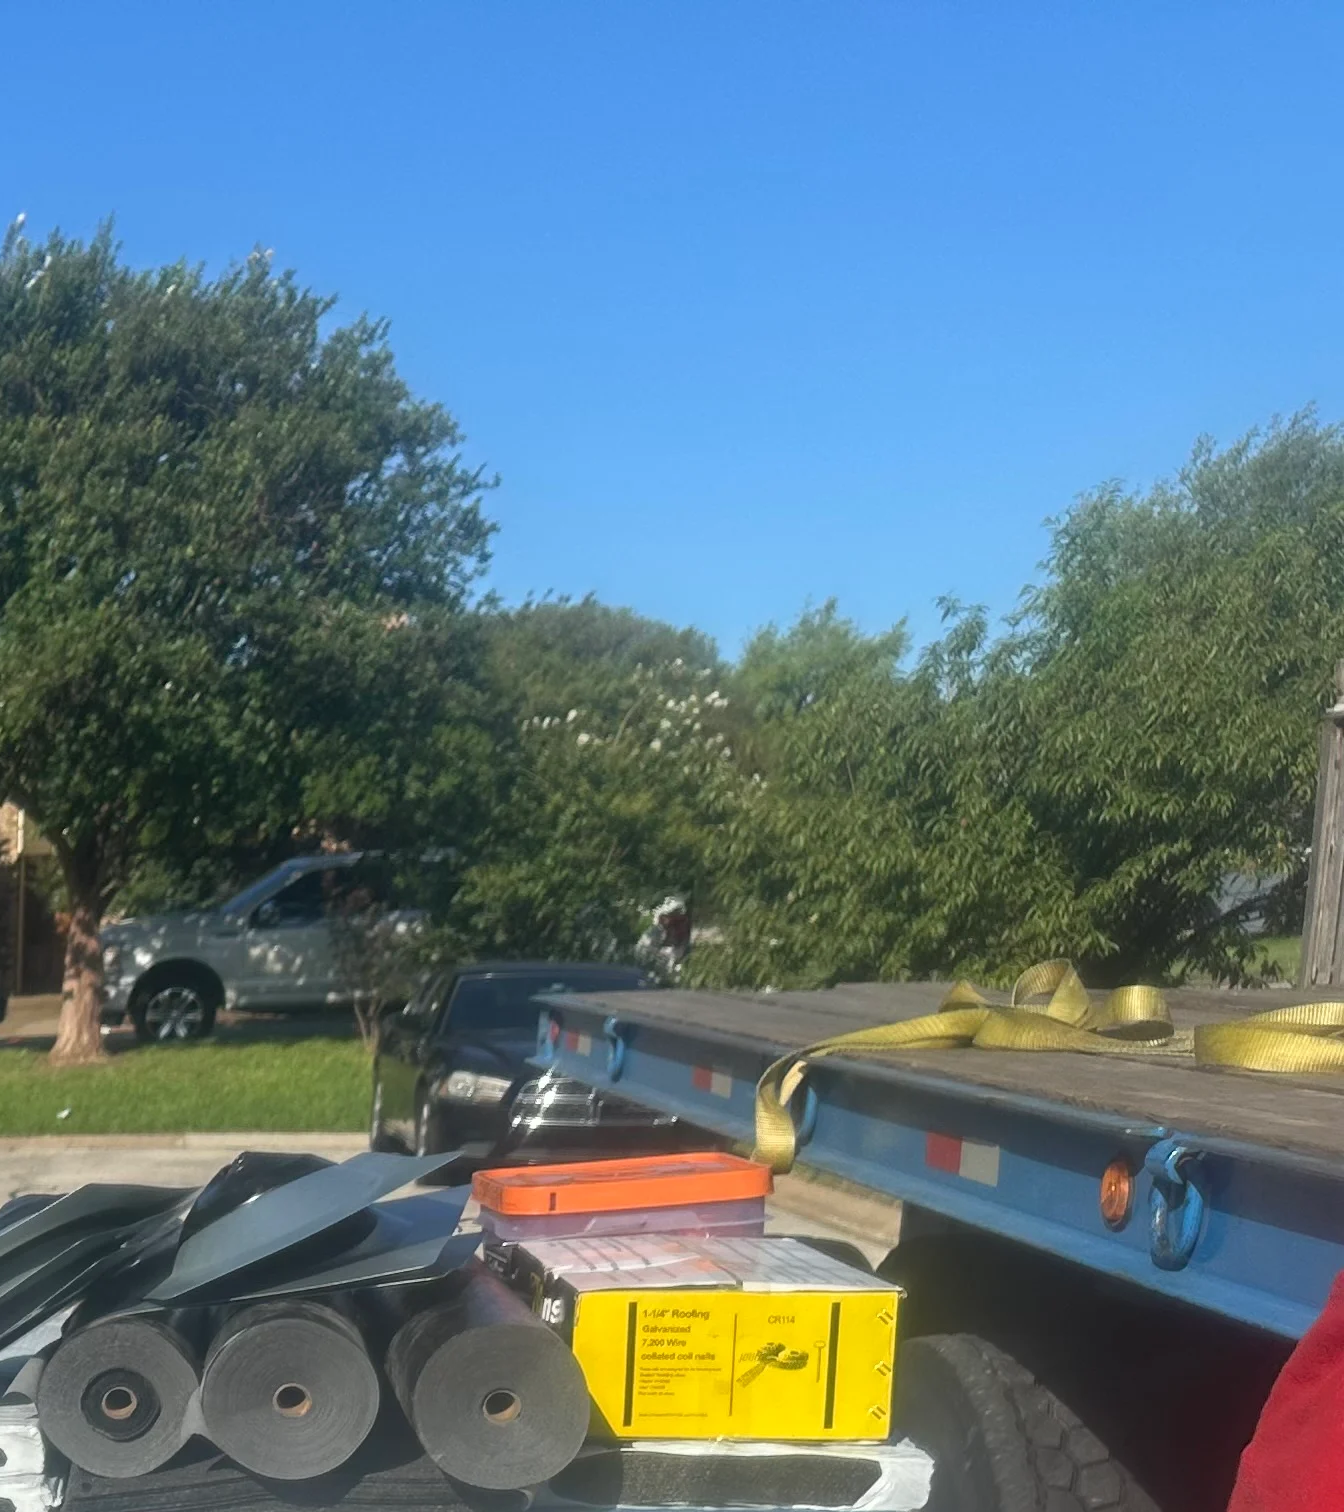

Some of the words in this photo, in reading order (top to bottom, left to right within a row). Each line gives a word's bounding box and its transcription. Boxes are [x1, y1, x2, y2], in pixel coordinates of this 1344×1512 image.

[672, 1309, 710, 1320] Roofing
[768, 1315, 795, 1324] CR114
[642, 1325, 691, 1333] Galvanized
[667, 1339, 687, 1347] Wire
[641, 1352, 675, 1360] collated
[677, 1352, 693, 1360] coil
[695, 1352, 715, 1360] nails
